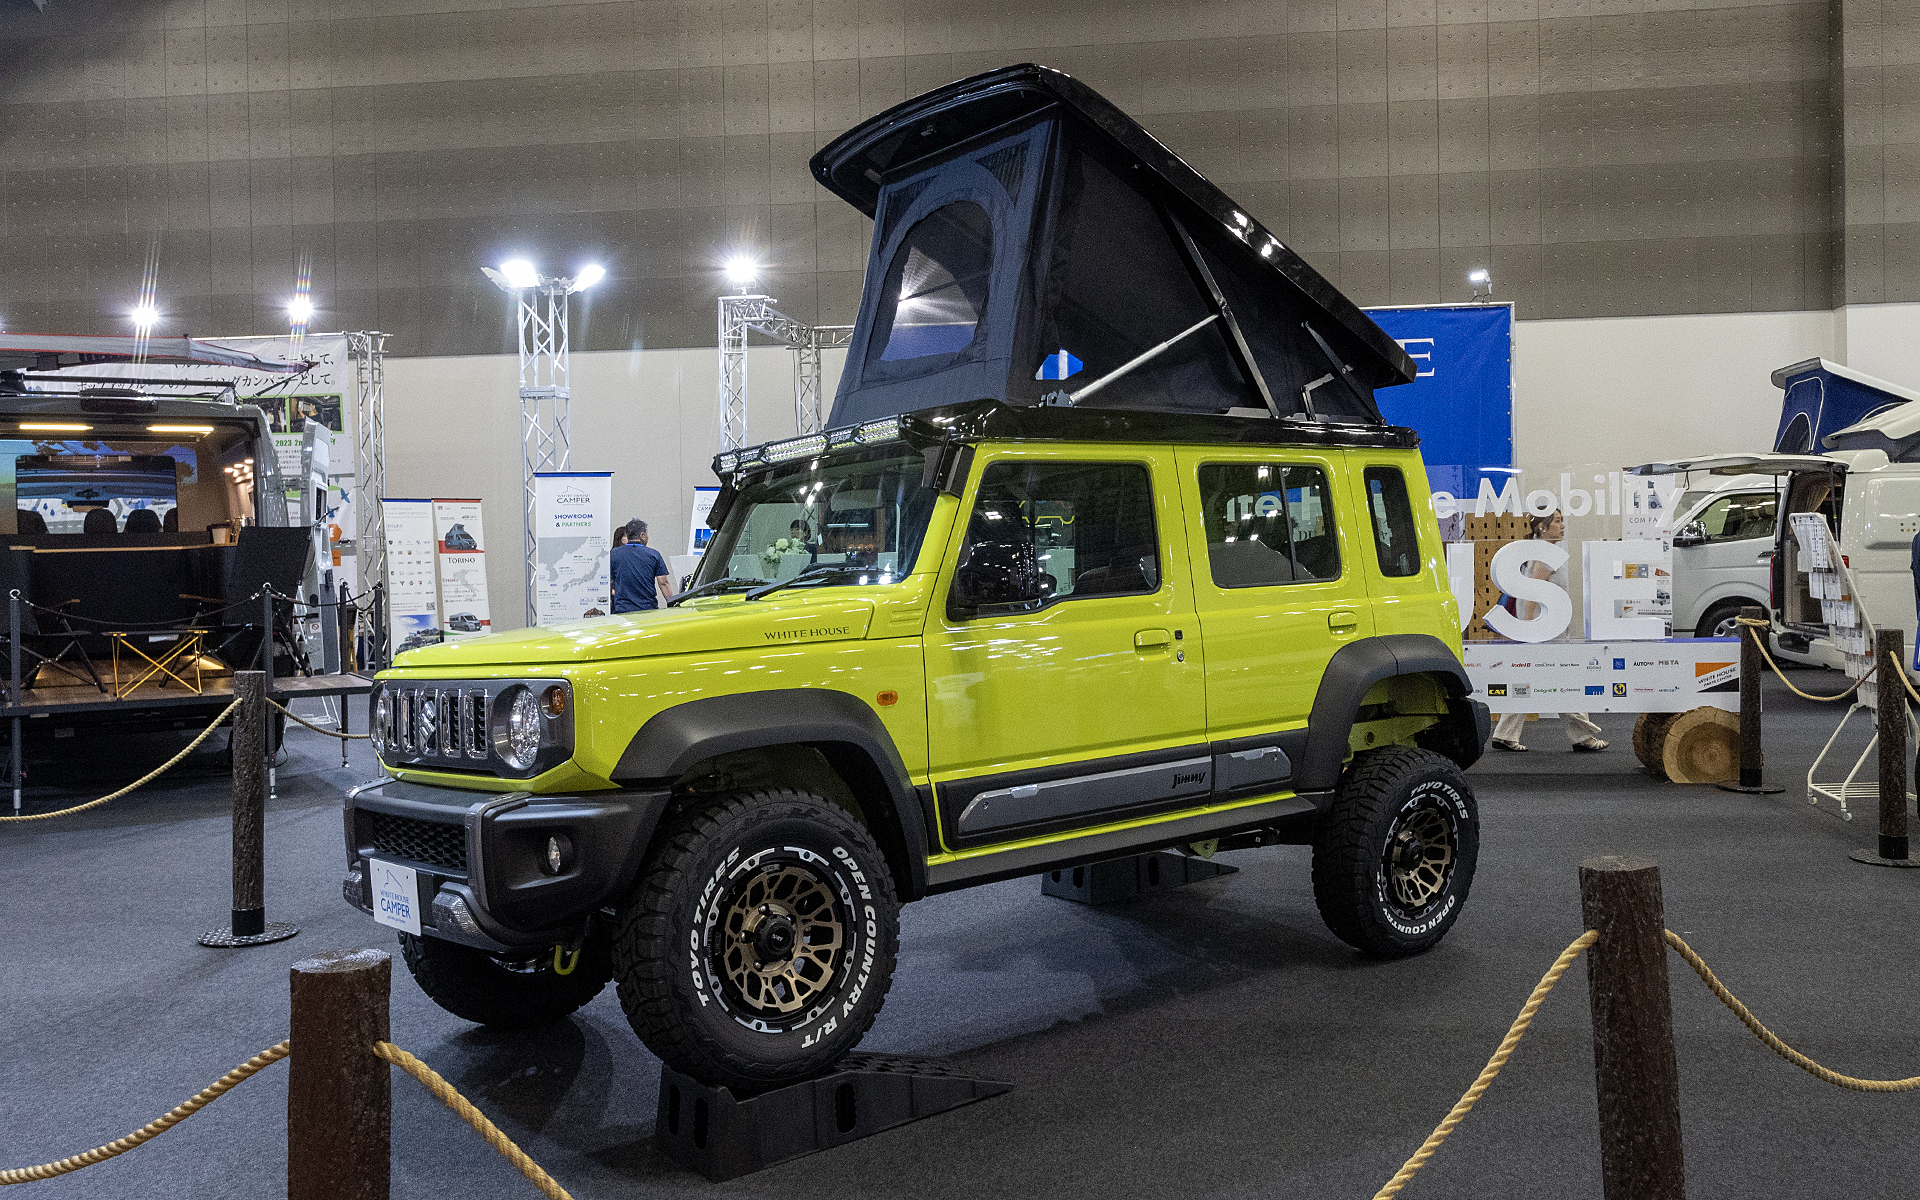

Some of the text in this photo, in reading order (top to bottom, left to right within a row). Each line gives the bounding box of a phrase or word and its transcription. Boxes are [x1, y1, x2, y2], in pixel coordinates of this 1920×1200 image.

[1474, 471, 1687, 527] Mobility
[764, 626, 850, 640] WHITE HOUSE
[1698, 667, 1735, 684] WHITE HOUSE
[1171, 771, 1206, 789] Jimny
[1410, 781, 1469, 819] TOYO TIRES
[380, 889, 409, 904] WHITE HOUSE
[380, 898, 411, 919] CAMPER
[1382, 907, 1427, 935] COUNTRY
[1428, 894, 1455, 929] OPEN
[690, 846, 740, 1007] TOYO TIRES
[801, 846, 877, 1048] OPEN COUNTRY R/T
